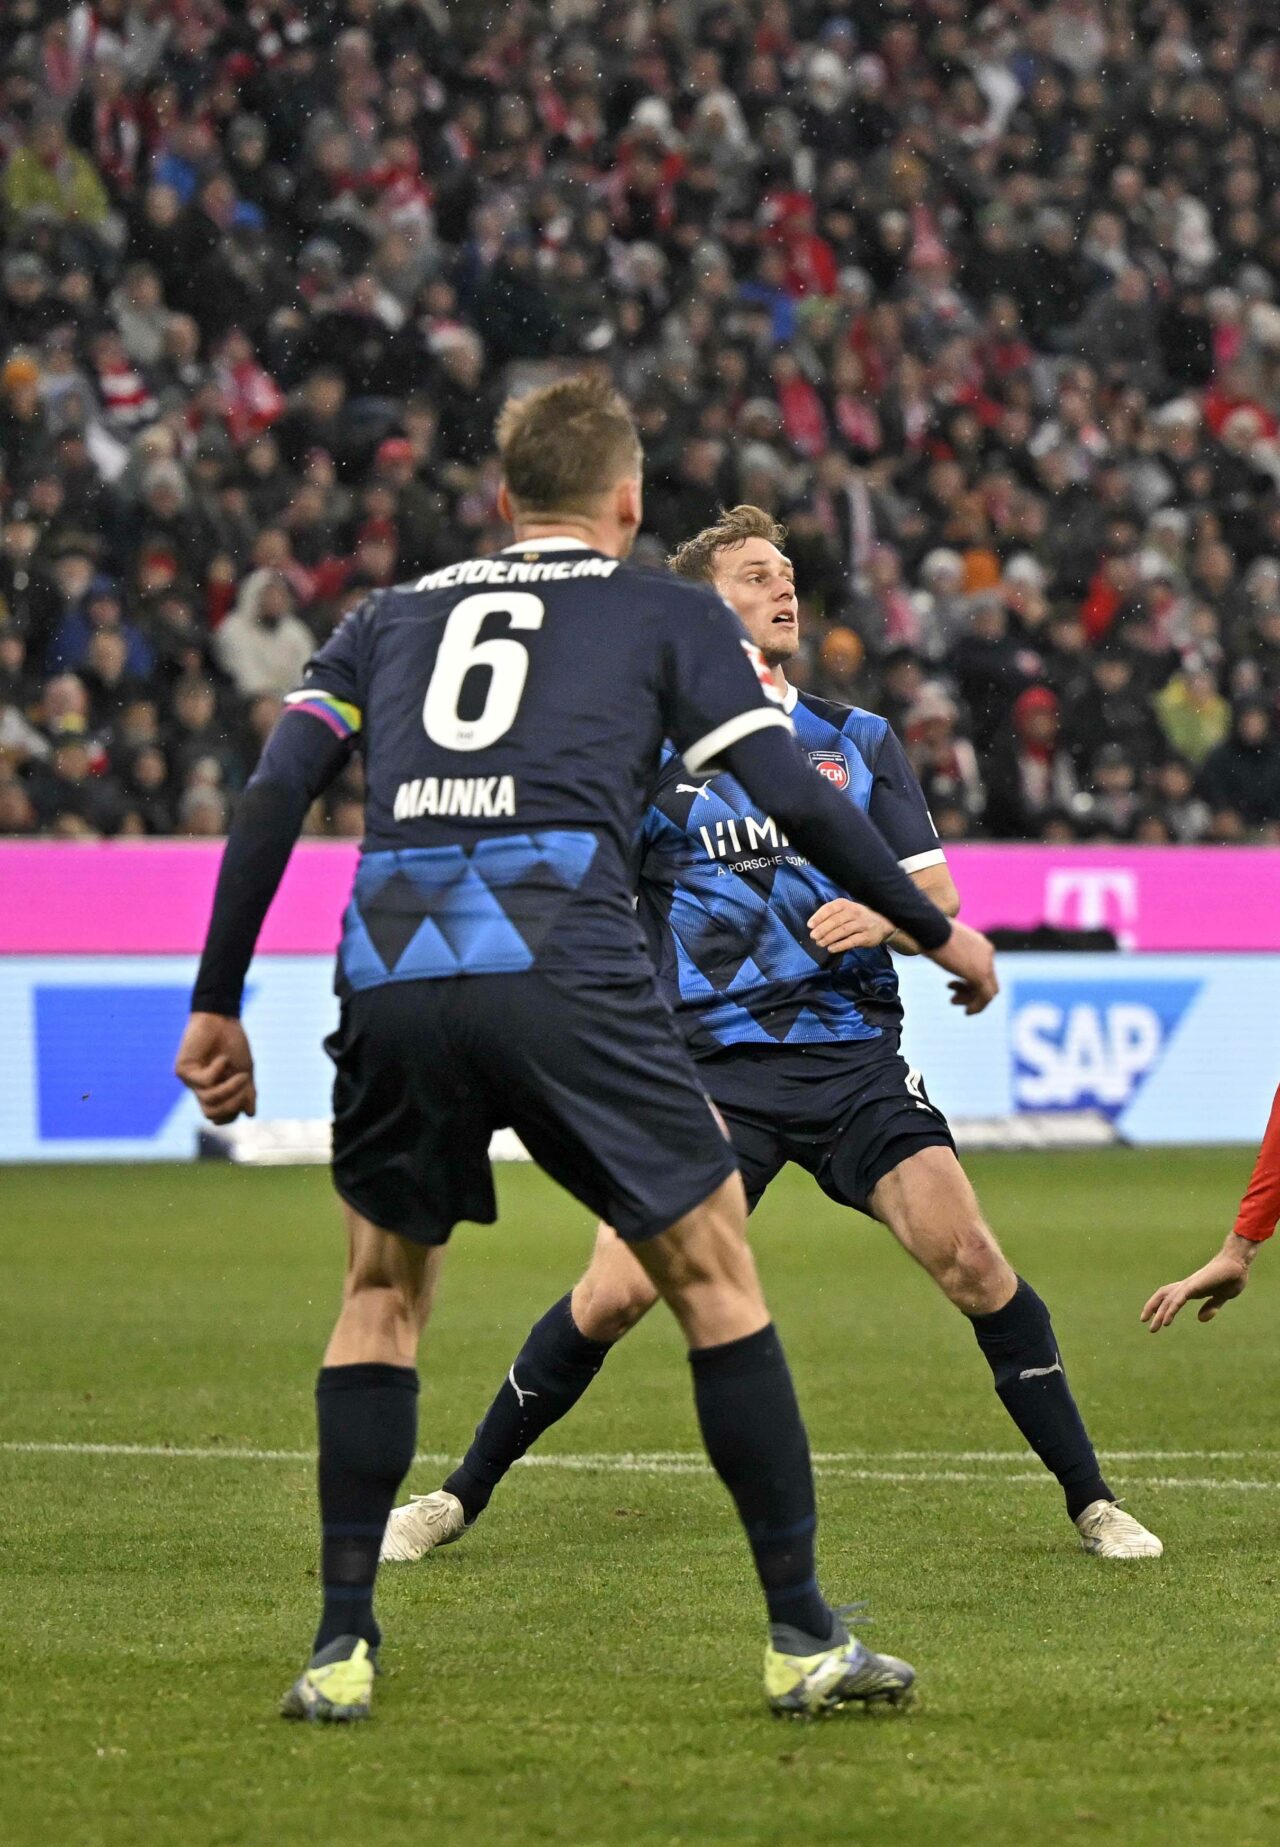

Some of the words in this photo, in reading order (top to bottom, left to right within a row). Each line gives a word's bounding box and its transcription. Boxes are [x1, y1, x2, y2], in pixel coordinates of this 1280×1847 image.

[422, 591, 545, 752] 6
[393, 775, 516, 821] MAINKA
[727, 855, 783, 874] PORSCHE
[785, 855, 811, 867] COM
[1013, 1003, 1161, 1105] SAP
